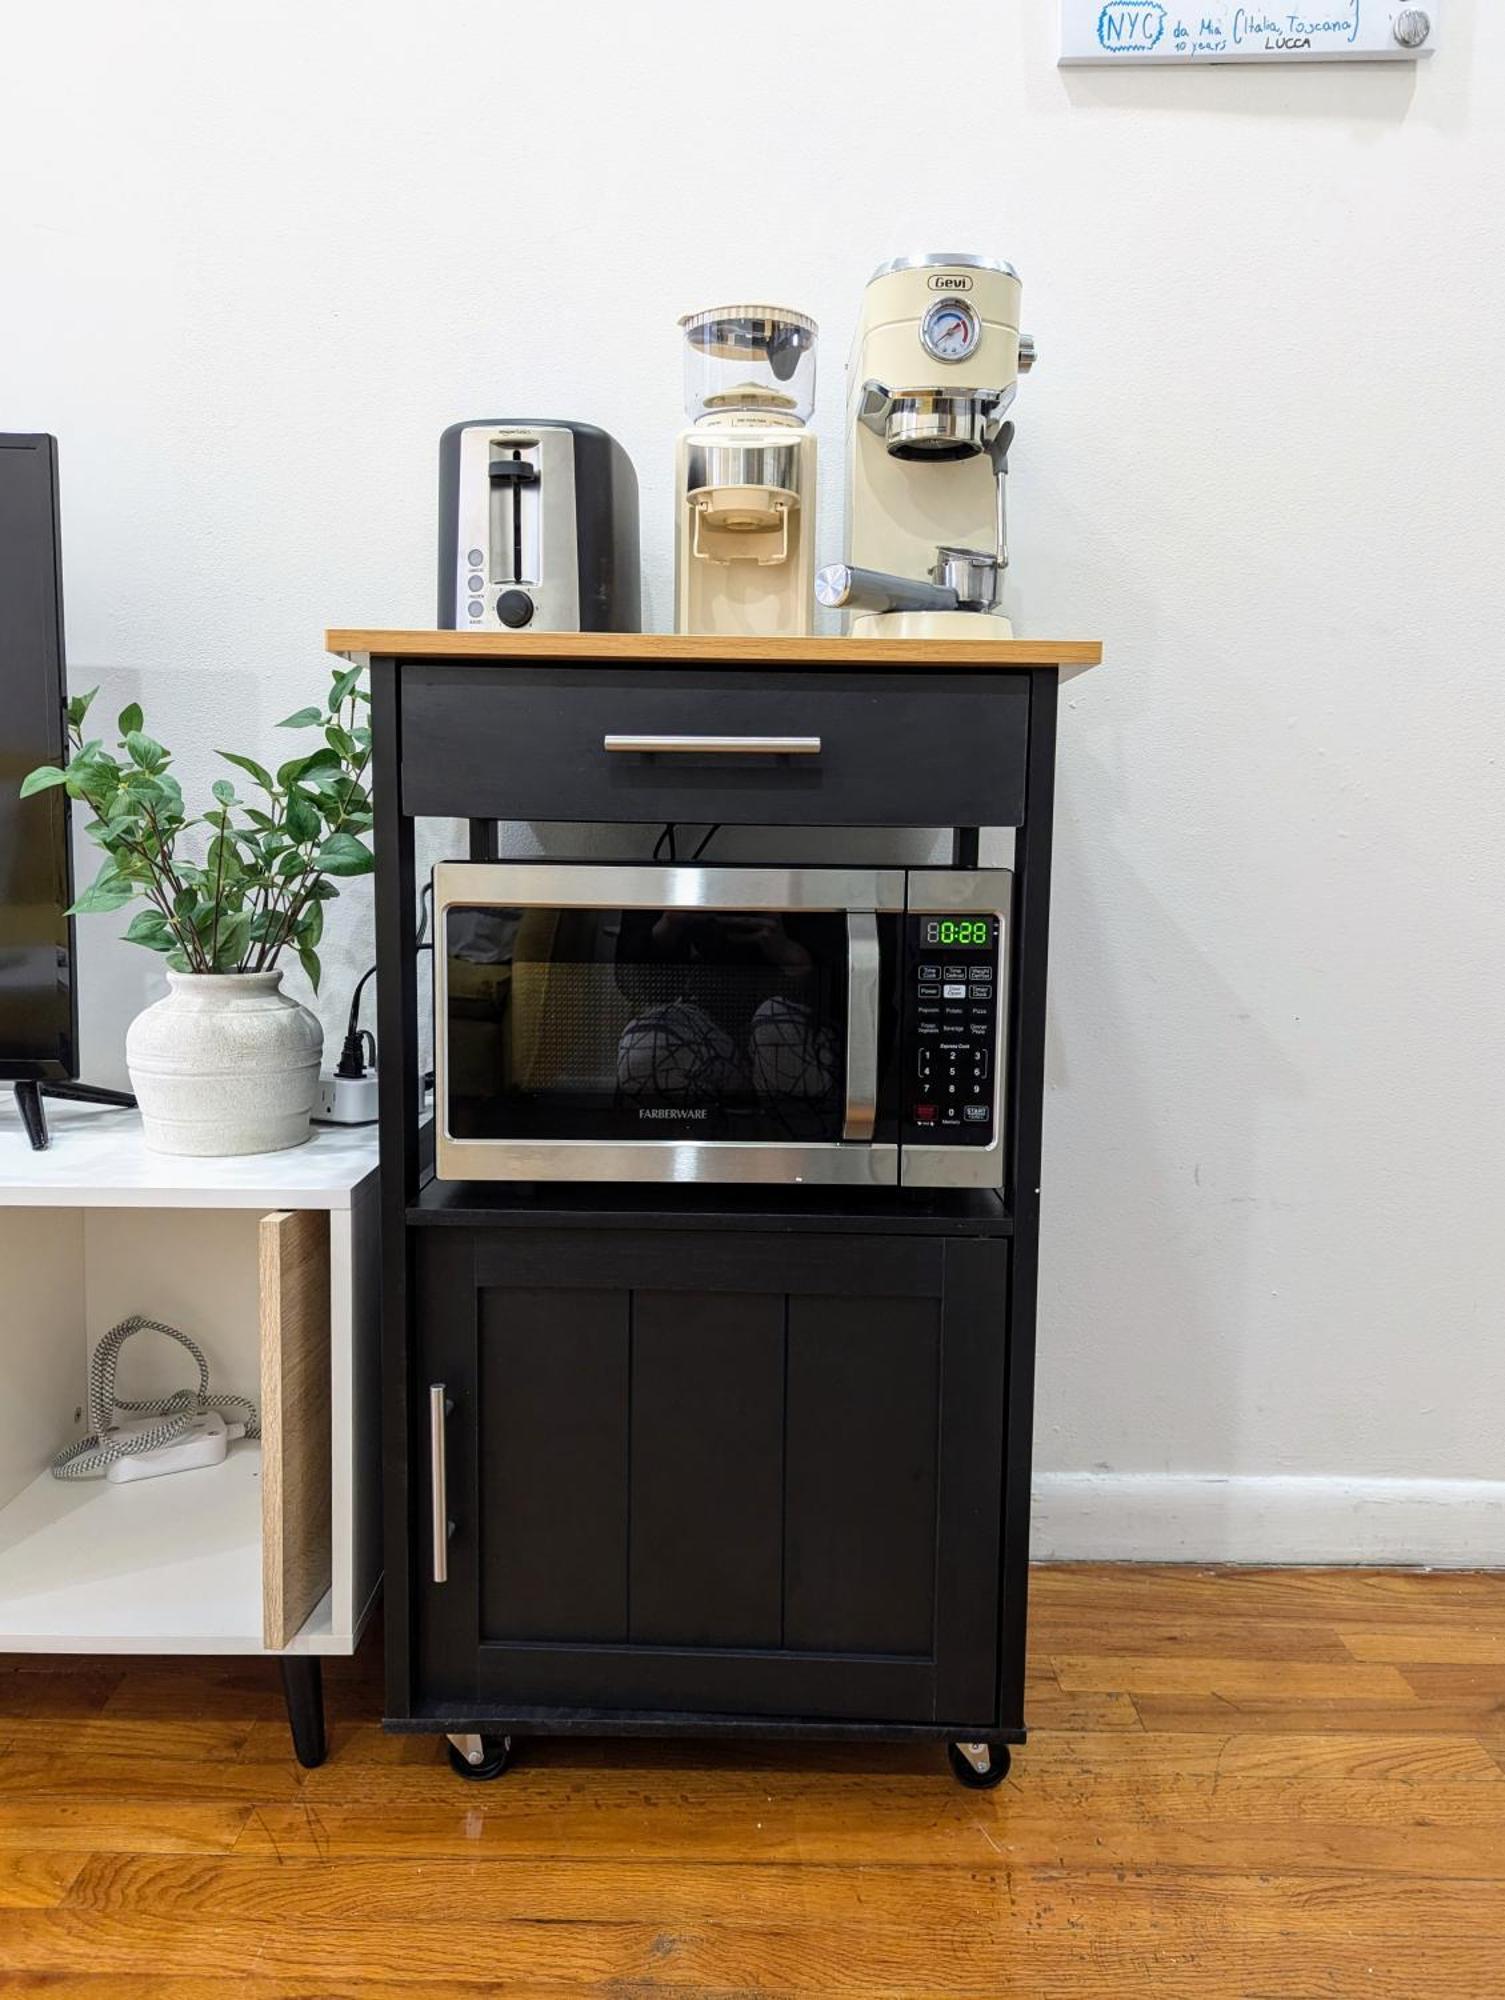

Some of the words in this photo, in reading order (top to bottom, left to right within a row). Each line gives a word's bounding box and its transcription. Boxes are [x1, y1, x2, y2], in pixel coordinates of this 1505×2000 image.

[1106, 11, 1154, 41] NYC
[1173, 20, 1189, 38] da
[1264, 36, 1311, 50] LUCCA
[1191, 39, 1227, 57] years
[935, 277, 966, 289] Gevi
[925, 1051, 930, 1060] 1
[950, 1051, 957, 1060] 2
[974, 1051, 981, 1060] 3
[924, 1067, 930, 1075] 4
[949, 1067, 956, 1075] 5
[974, 1068, 980, 1076] 6
[924, 1084, 930, 1093] 7
[949, 1085, 956, 1093] 8
[973, 1085, 980, 1093] 9
[639, 1108, 708, 1119] FARBERWARE
